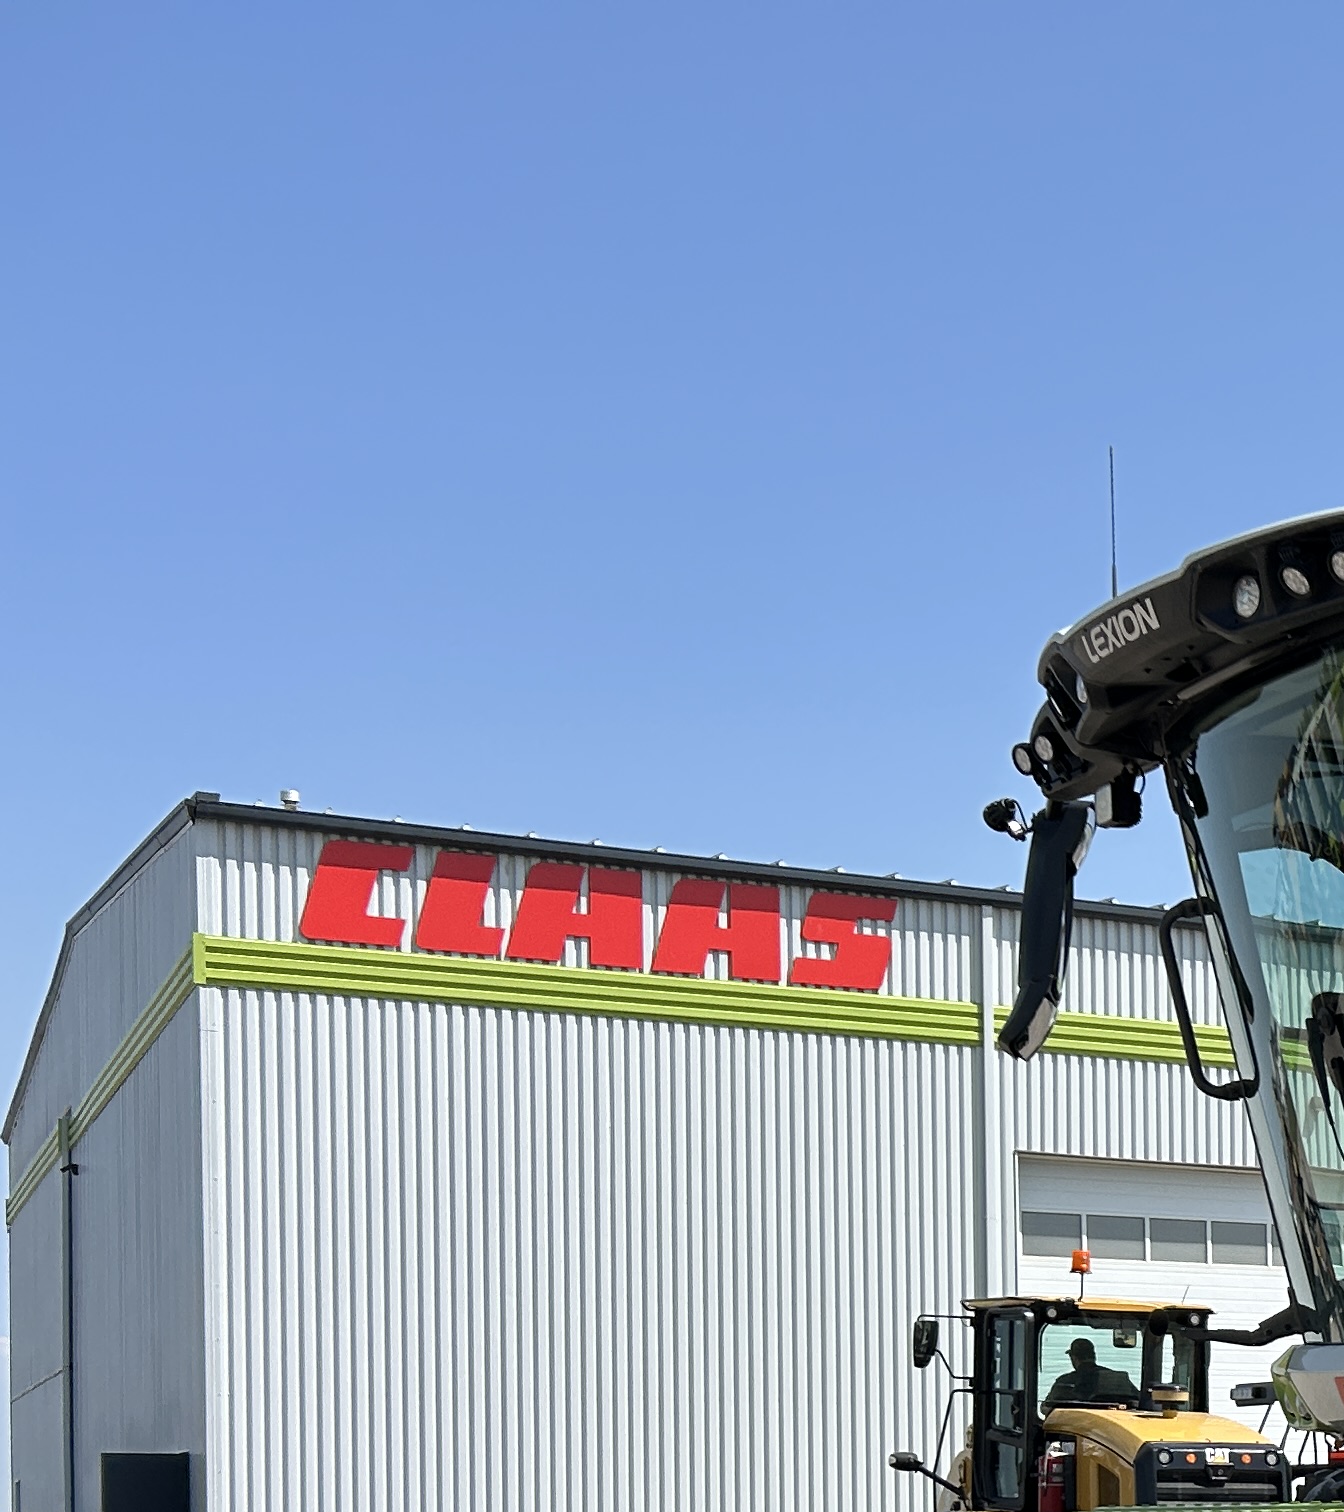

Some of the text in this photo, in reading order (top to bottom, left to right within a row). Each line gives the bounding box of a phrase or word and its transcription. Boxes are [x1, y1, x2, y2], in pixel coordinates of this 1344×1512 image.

[1081, 597, 1160, 663] LEXION
[300, 839, 898, 990] CLAAS
[1205, 1448, 1230, 1463] CAT
